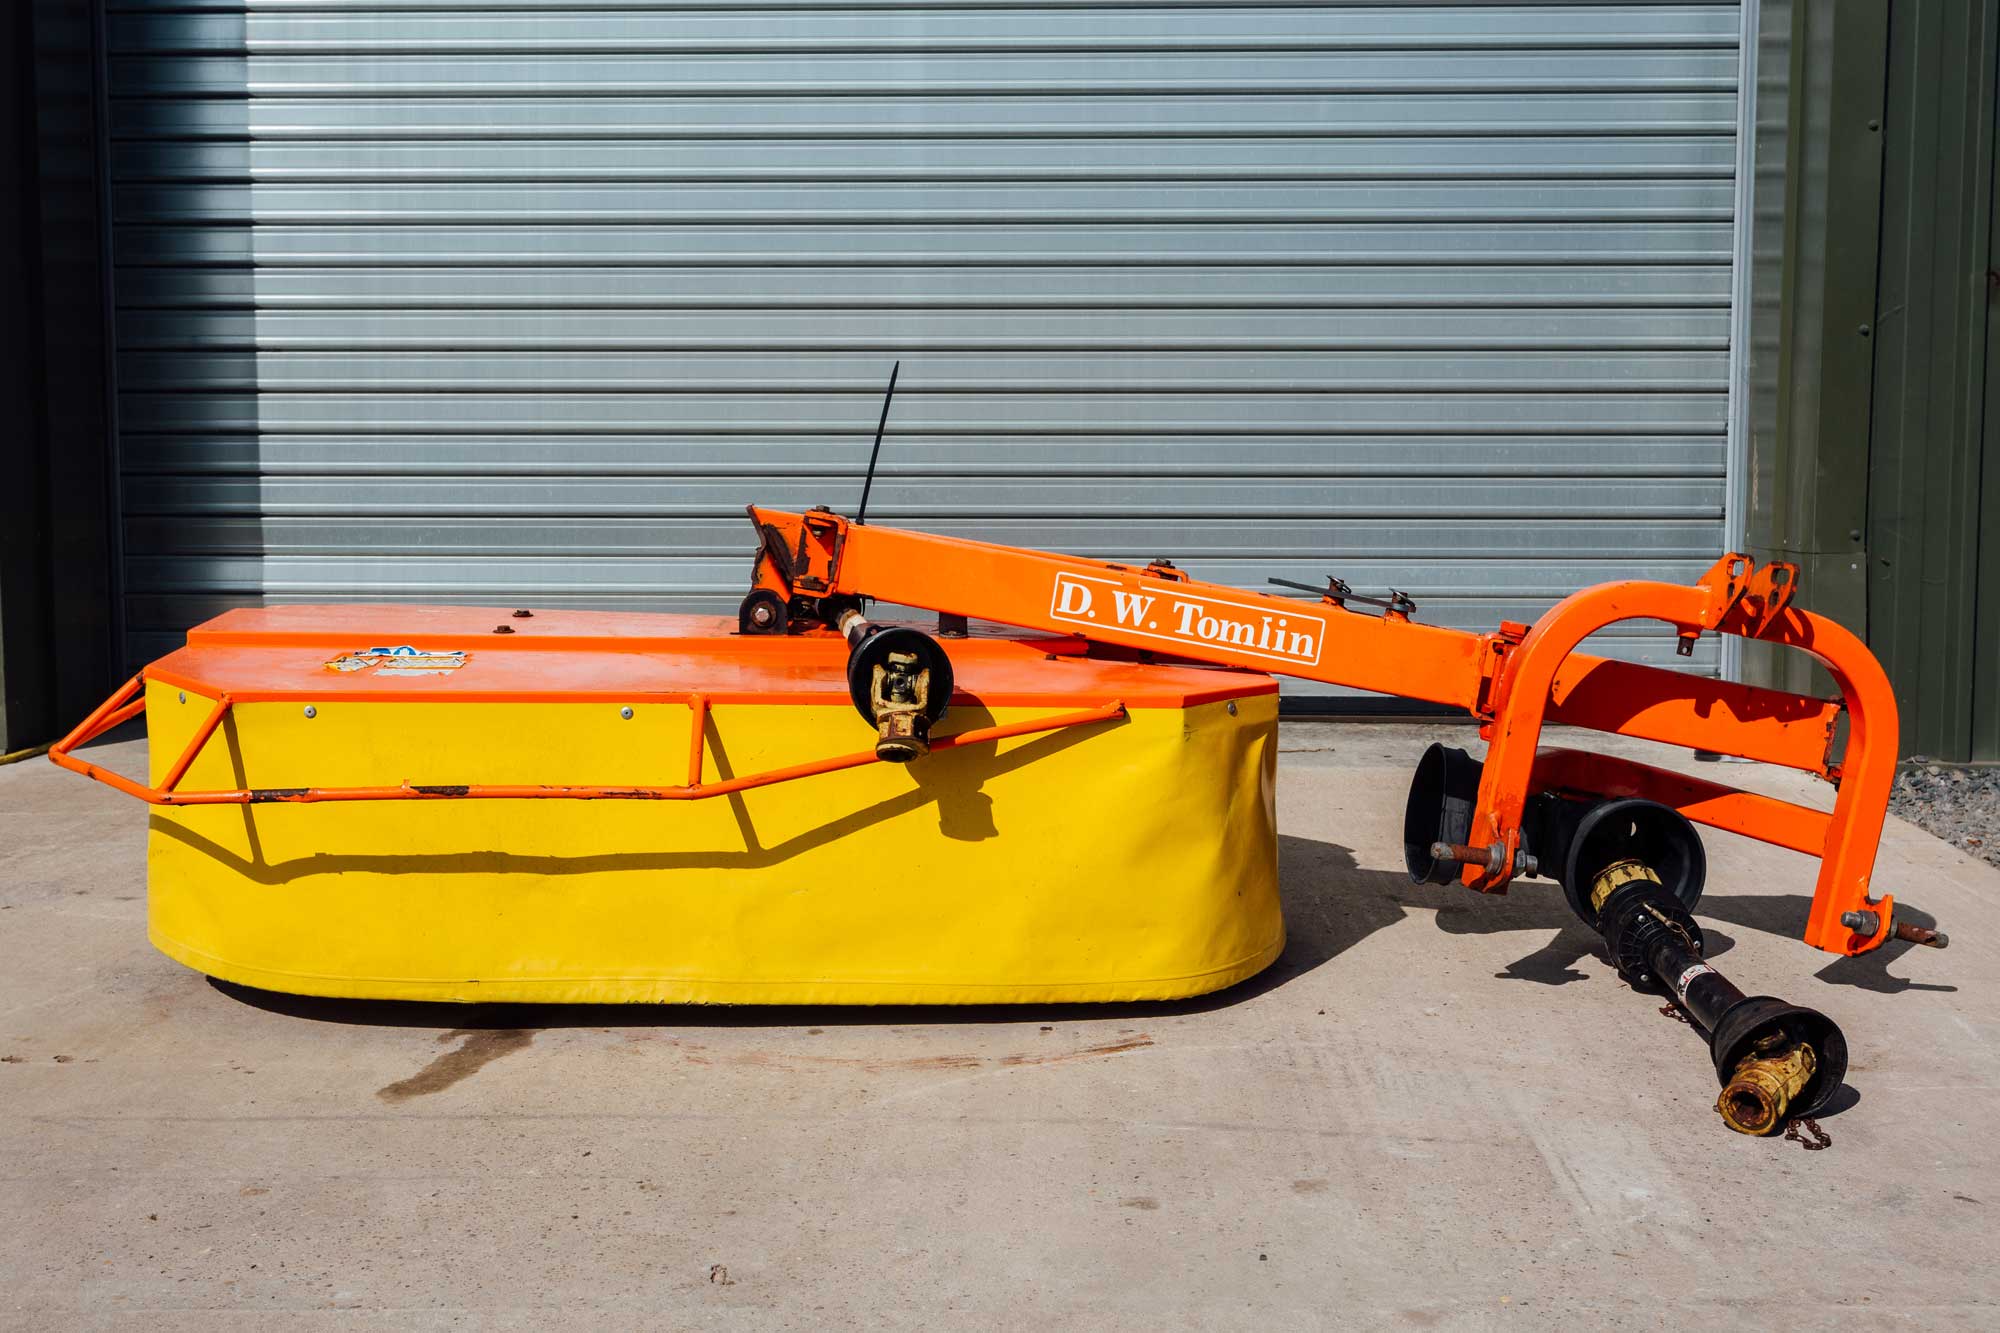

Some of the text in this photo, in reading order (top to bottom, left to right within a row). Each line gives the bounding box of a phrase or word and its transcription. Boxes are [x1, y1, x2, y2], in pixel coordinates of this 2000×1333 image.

[1056, 581, 1315, 658] D. W. Tomlin
